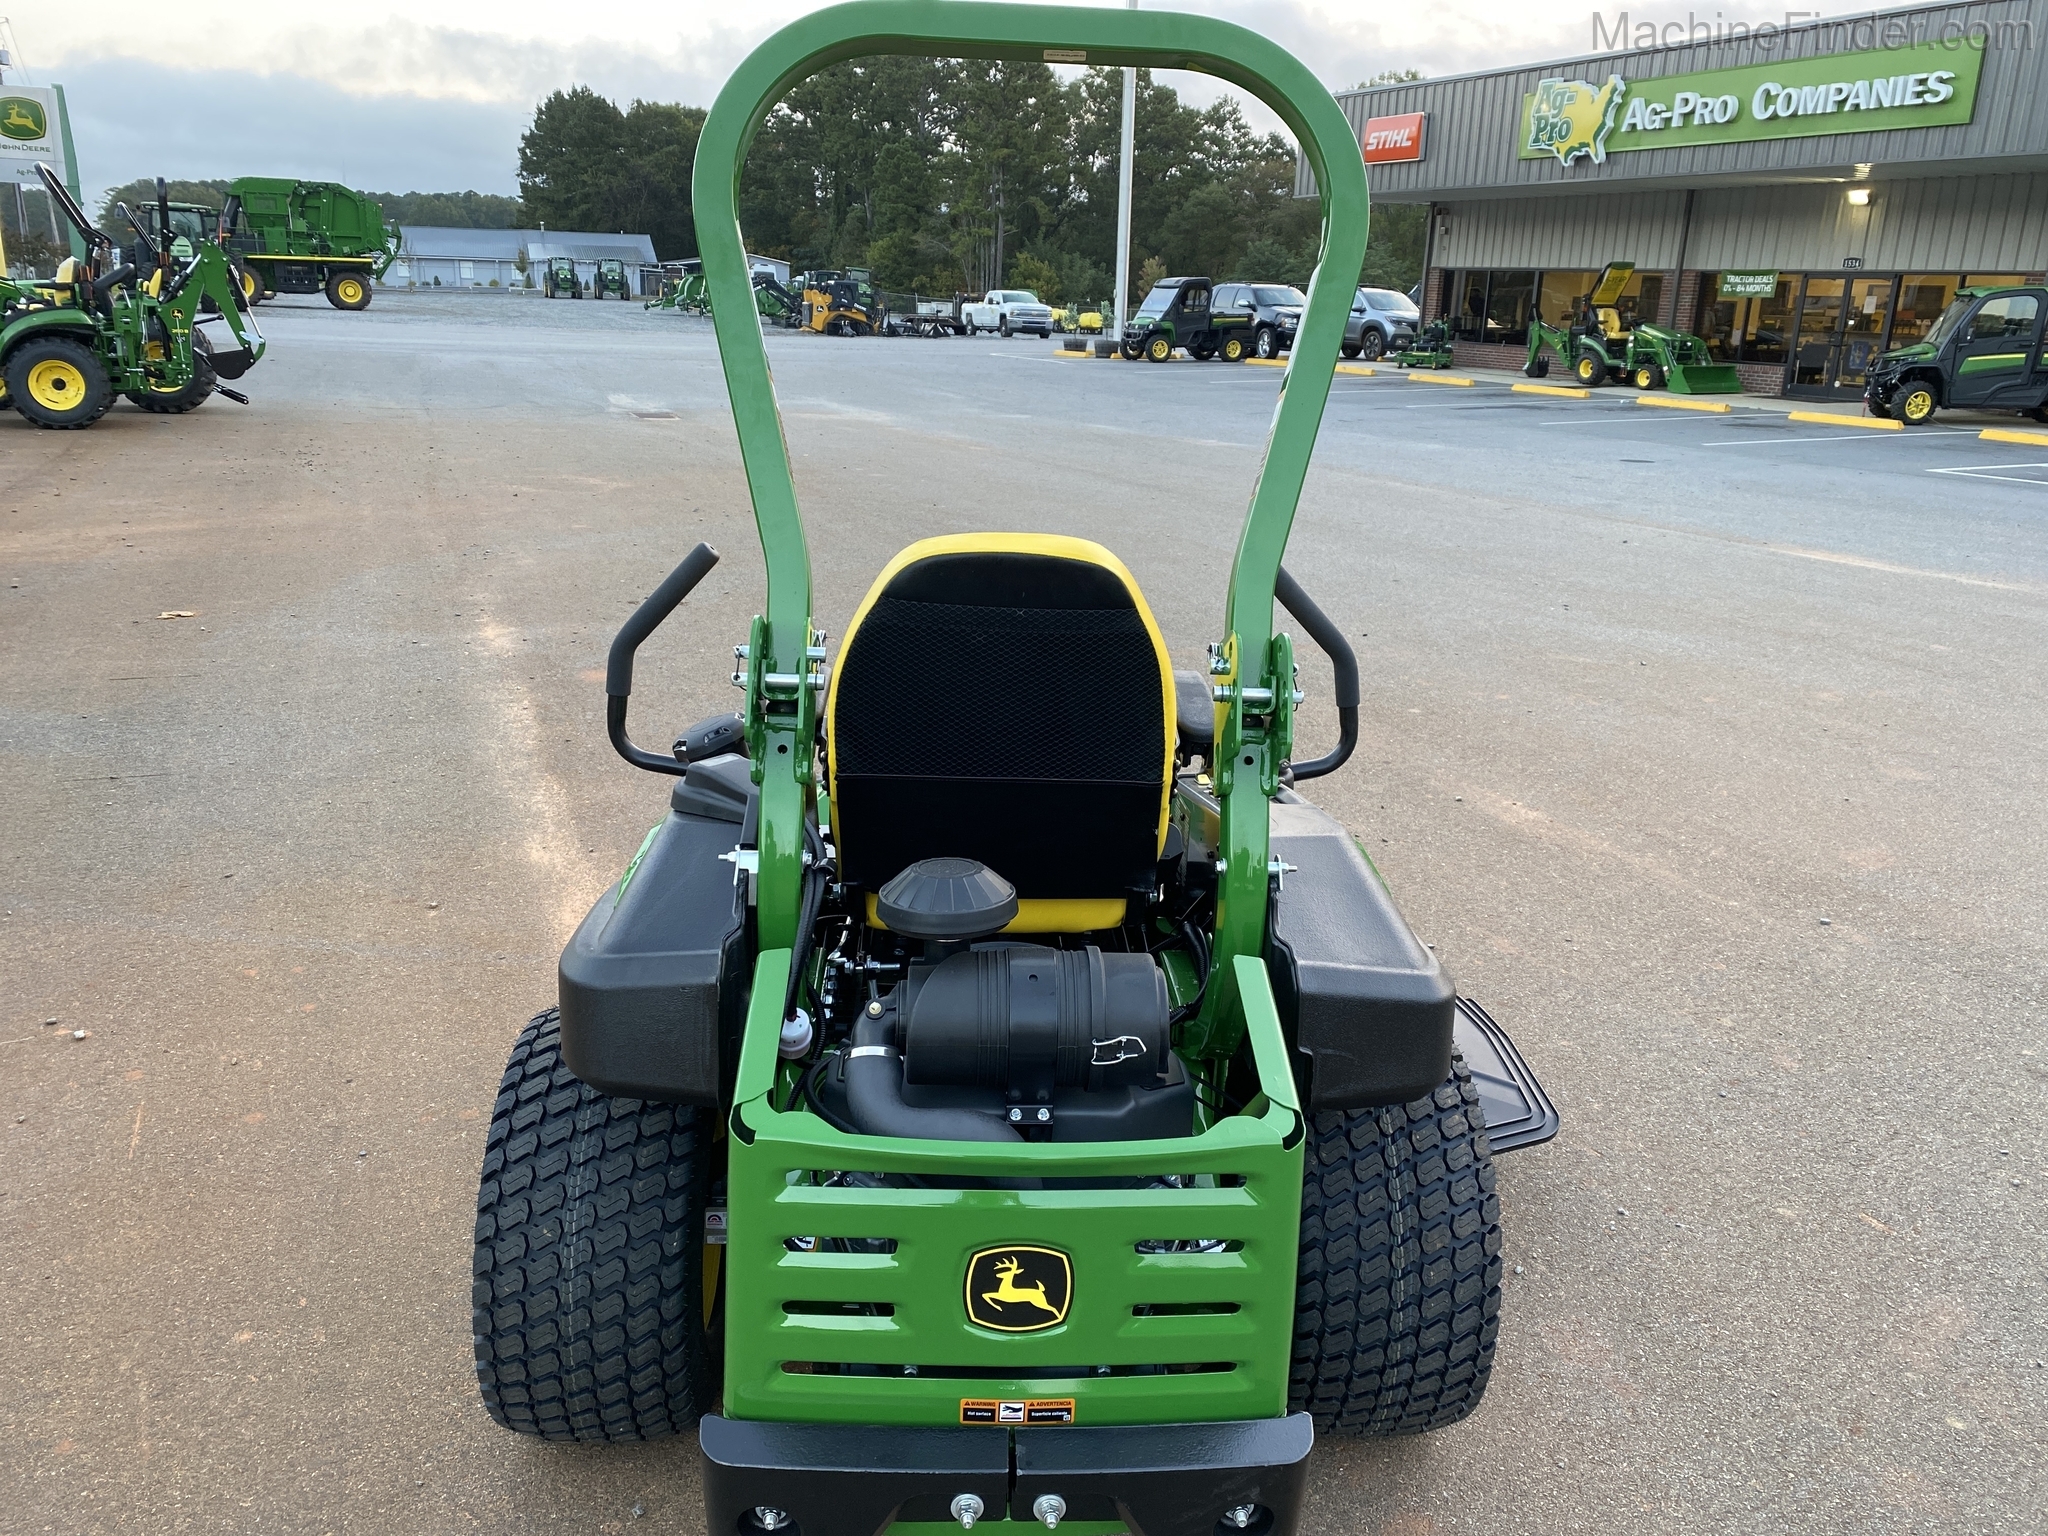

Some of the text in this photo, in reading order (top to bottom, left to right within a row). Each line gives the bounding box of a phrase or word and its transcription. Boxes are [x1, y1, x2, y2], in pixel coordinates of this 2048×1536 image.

[1752, 70, 1956, 120] COMPANIES
[1530, 114, 1574, 147] Pro
[1366, 128, 1412, 150] STIHL
[21, 144, 51, 152] DEERE
[1727, 275, 1774, 283] TRACTOR DEALS
[1745, 284, 1773, 292] MONTHS
